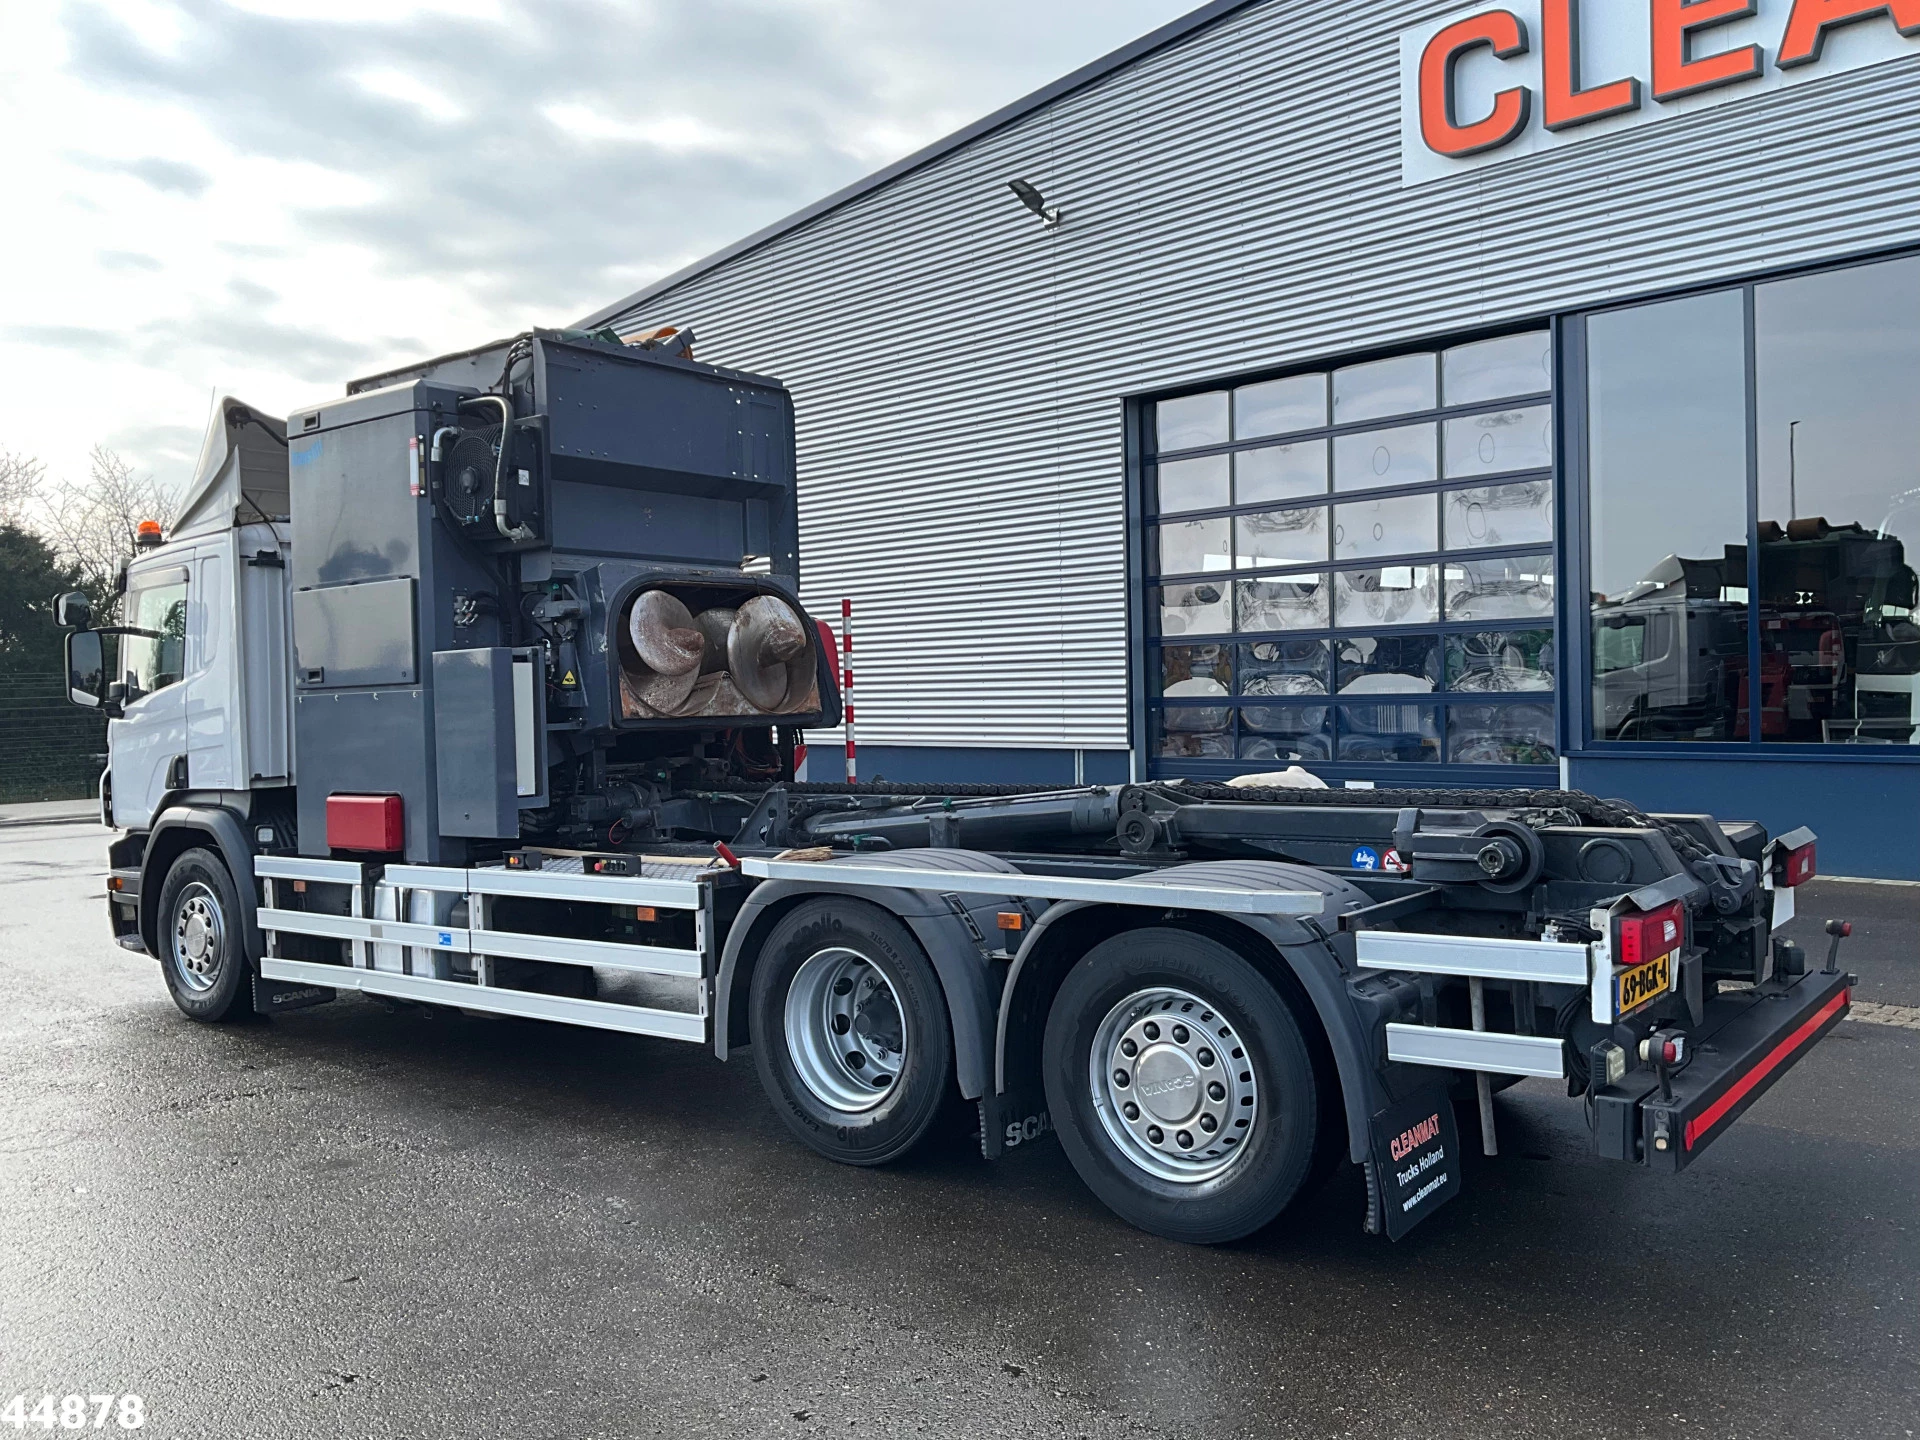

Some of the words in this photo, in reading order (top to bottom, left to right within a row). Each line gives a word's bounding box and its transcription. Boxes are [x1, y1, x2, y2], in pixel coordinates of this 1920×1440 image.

[272, 987, 321, 1004] SCANIA
[1622, 957, 1668, 1006] 69-BGK-4
[1005, 1111, 1053, 1147] SCA
[1390, 1113, 1440, 1162] CLEANMAT
[1396, 1163, 1419, 1187] Trucks
[1419, 1144, 1444, 1172] Holland
[1402, 1171, 1448, 1213] www.cleanmat.eu
